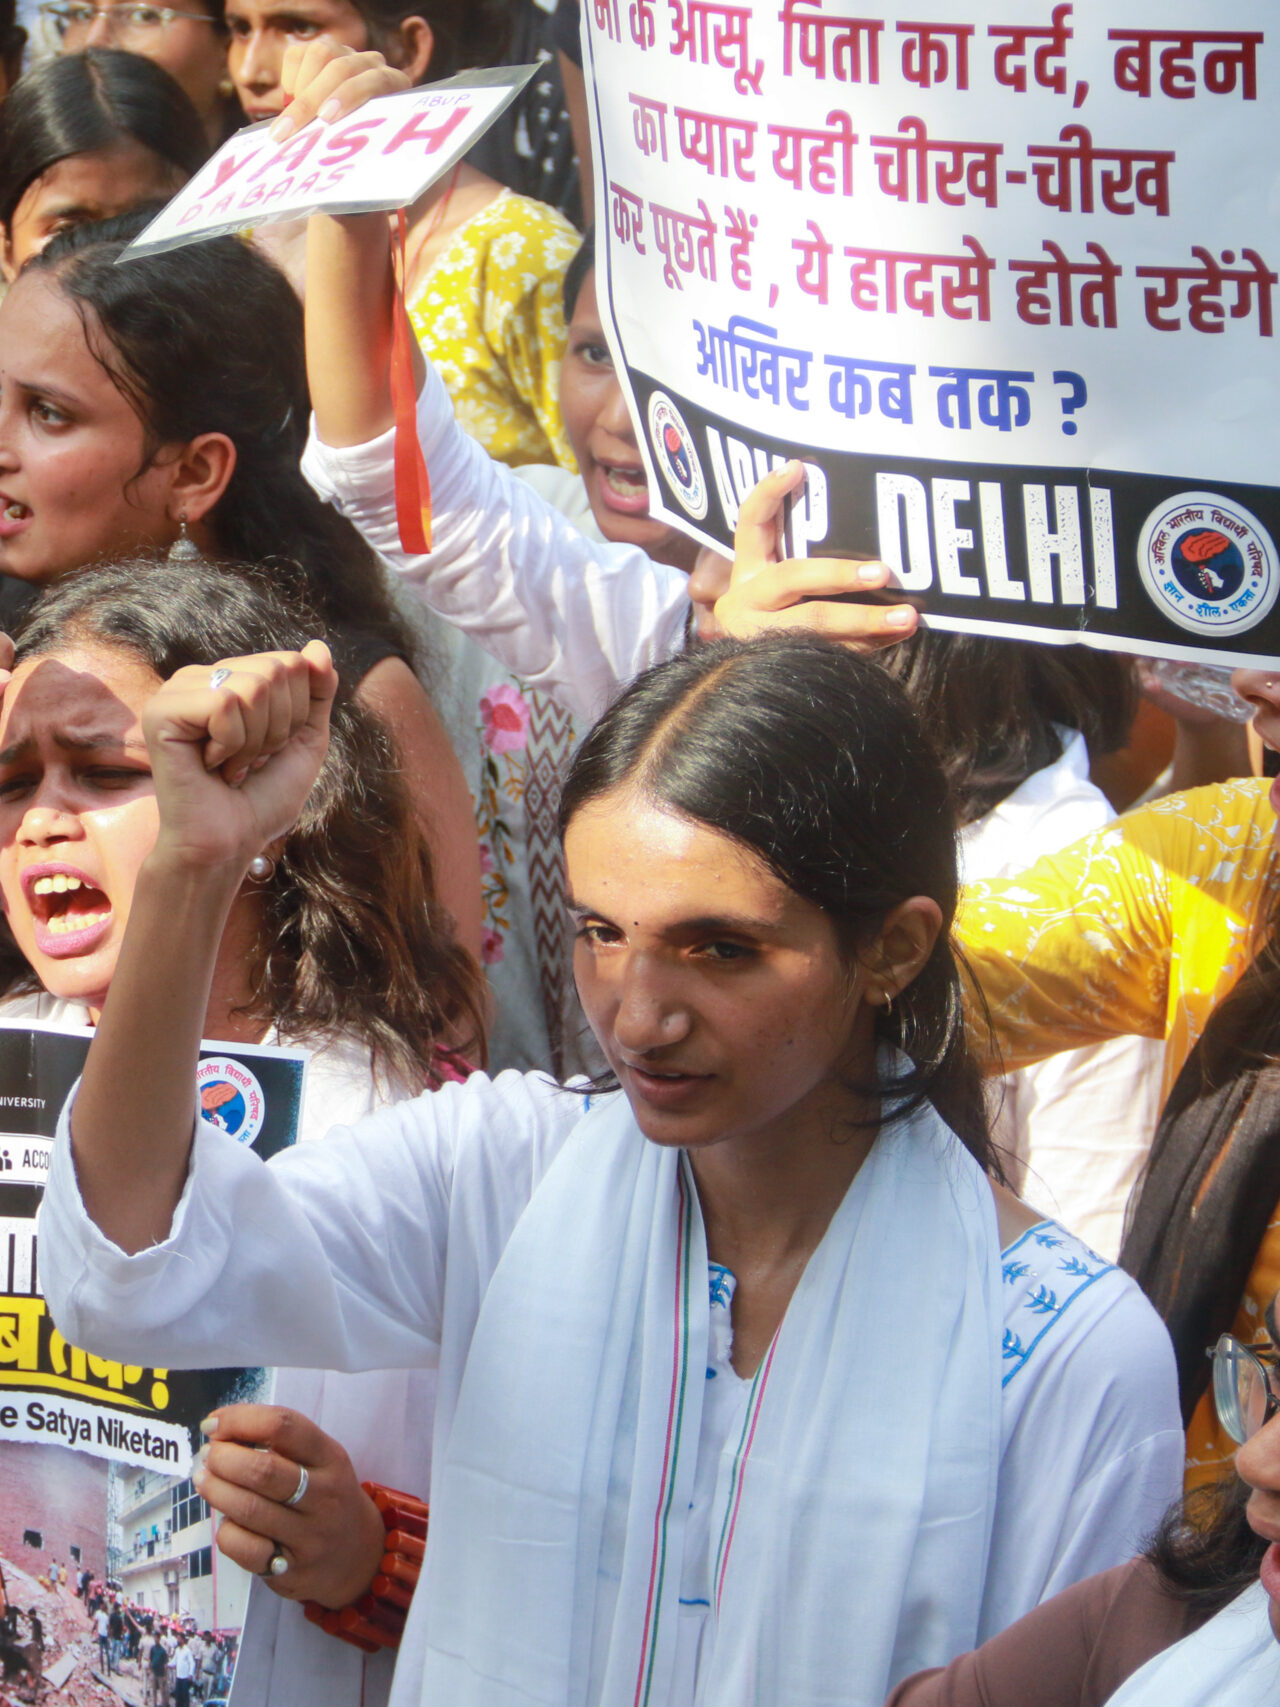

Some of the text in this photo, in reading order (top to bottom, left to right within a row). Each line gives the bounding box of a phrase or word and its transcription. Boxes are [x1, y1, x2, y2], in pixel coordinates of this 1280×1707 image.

[778, 0, 885, 85] पिता
[896, 21, 975, 90] का
[987, 2, 1090, 108] दर्द,
[1107, 28, 1264, 100] बहन
[199, 106, 473, 199] YASH
[629, 93, 1175, 217] का प्यार यही चीख-चीख
[609, 181, 646, 255] कर
[650, 198, 717, 291] पूछते
[792, 220, 833, 305] ये
[844, 235, 995, 322] हादसे
[1008, 240, 1121, 329] होते
[1135, 246, 1278, 338] रहेंगे
[693, 315, 812, 411] आखिर
[824, 355, 917, 425] कब
[928, 366, 1034, 433] तक
[875, 471, 1118, 610] DELHI
[1166, 509, 1204, 530] भारतीय
[25, 1401, 92, 1445] Satya
[97, 1416, 180, 1463] Niketan
